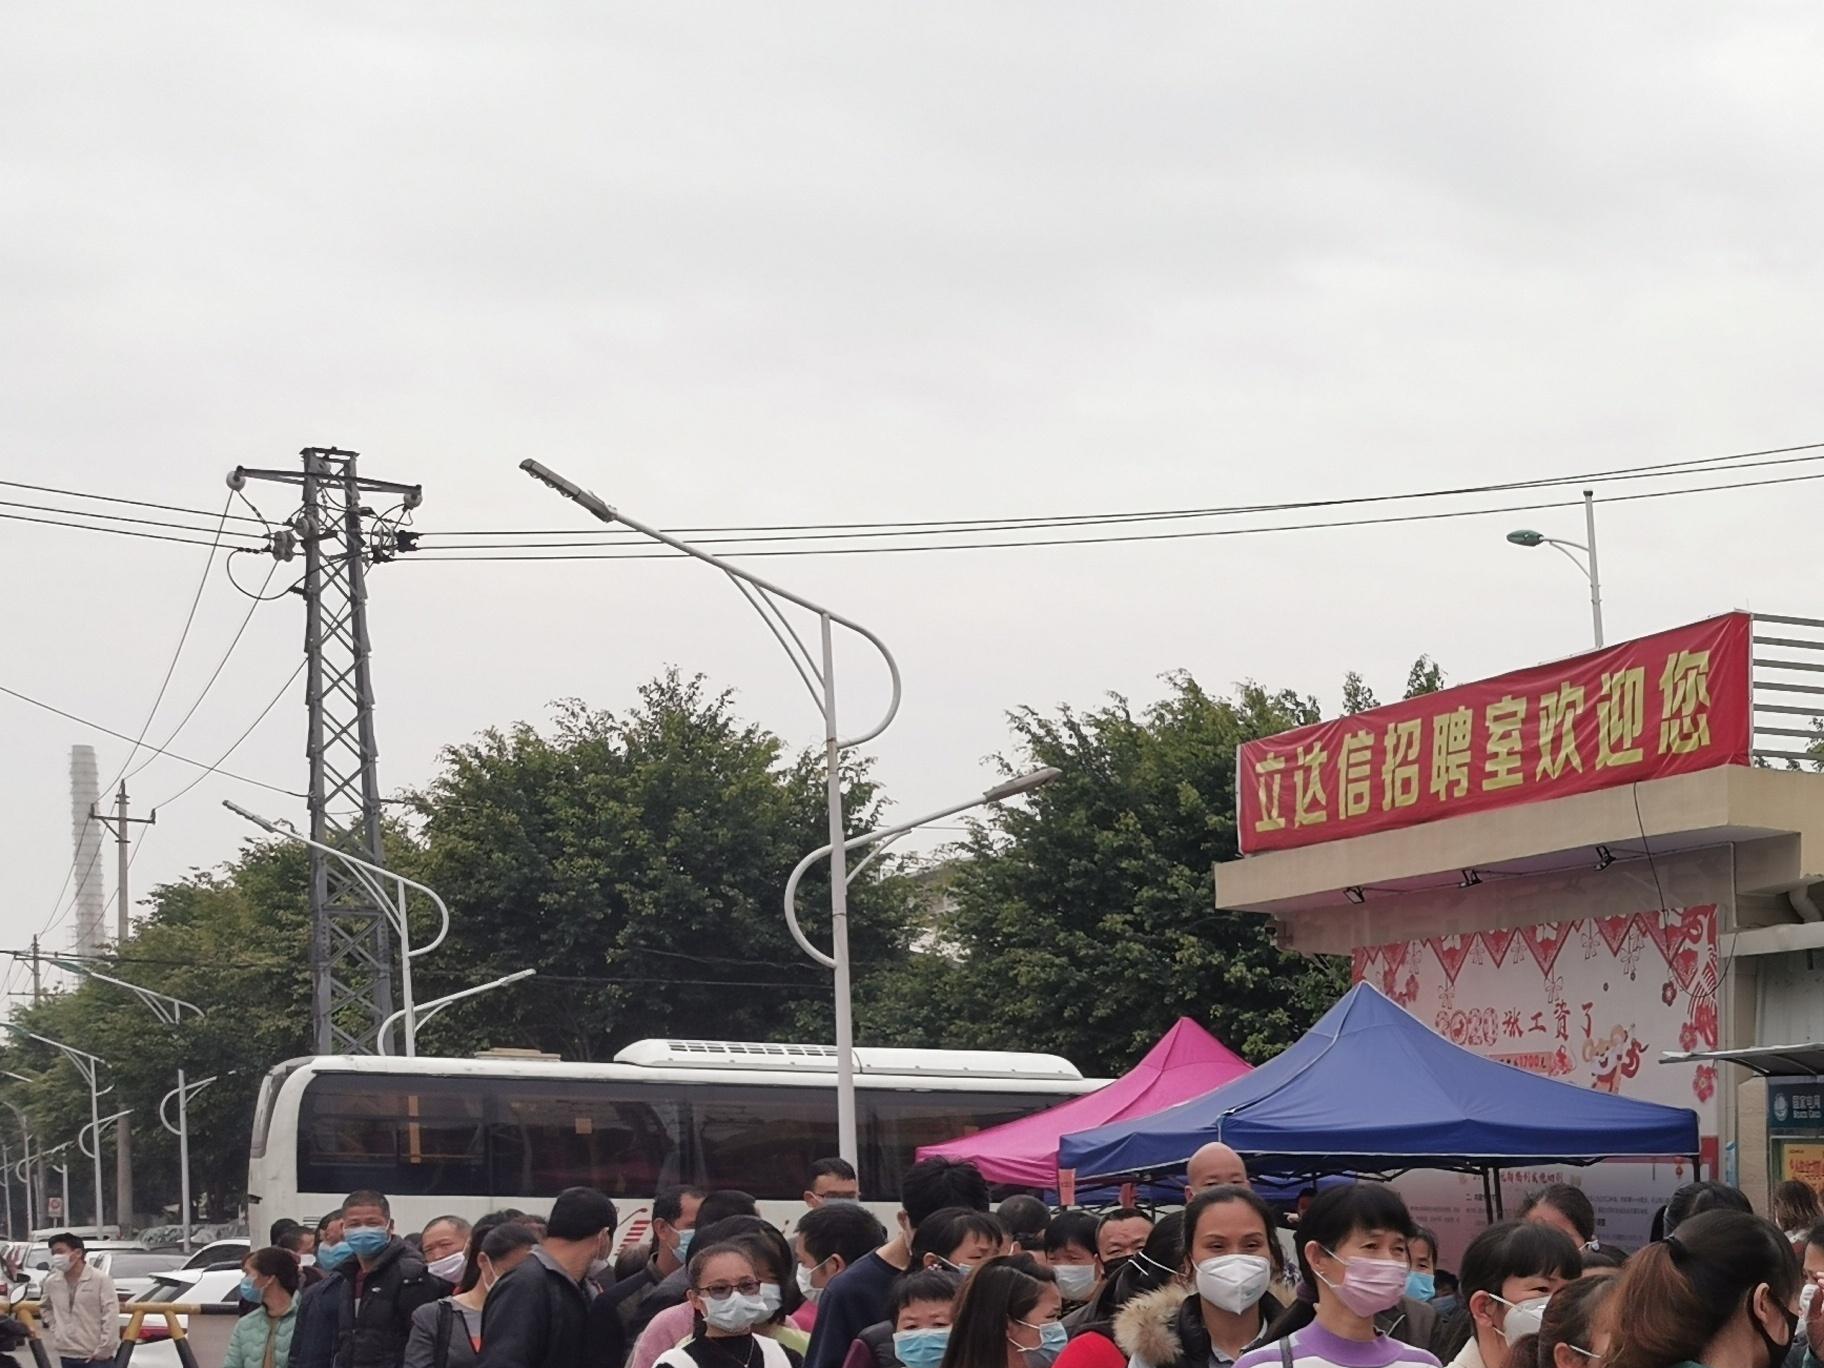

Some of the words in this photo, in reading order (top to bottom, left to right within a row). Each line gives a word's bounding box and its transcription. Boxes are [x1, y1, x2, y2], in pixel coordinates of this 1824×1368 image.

[1254, 649, 1712, 833] 立达信招聘室欢迎您
